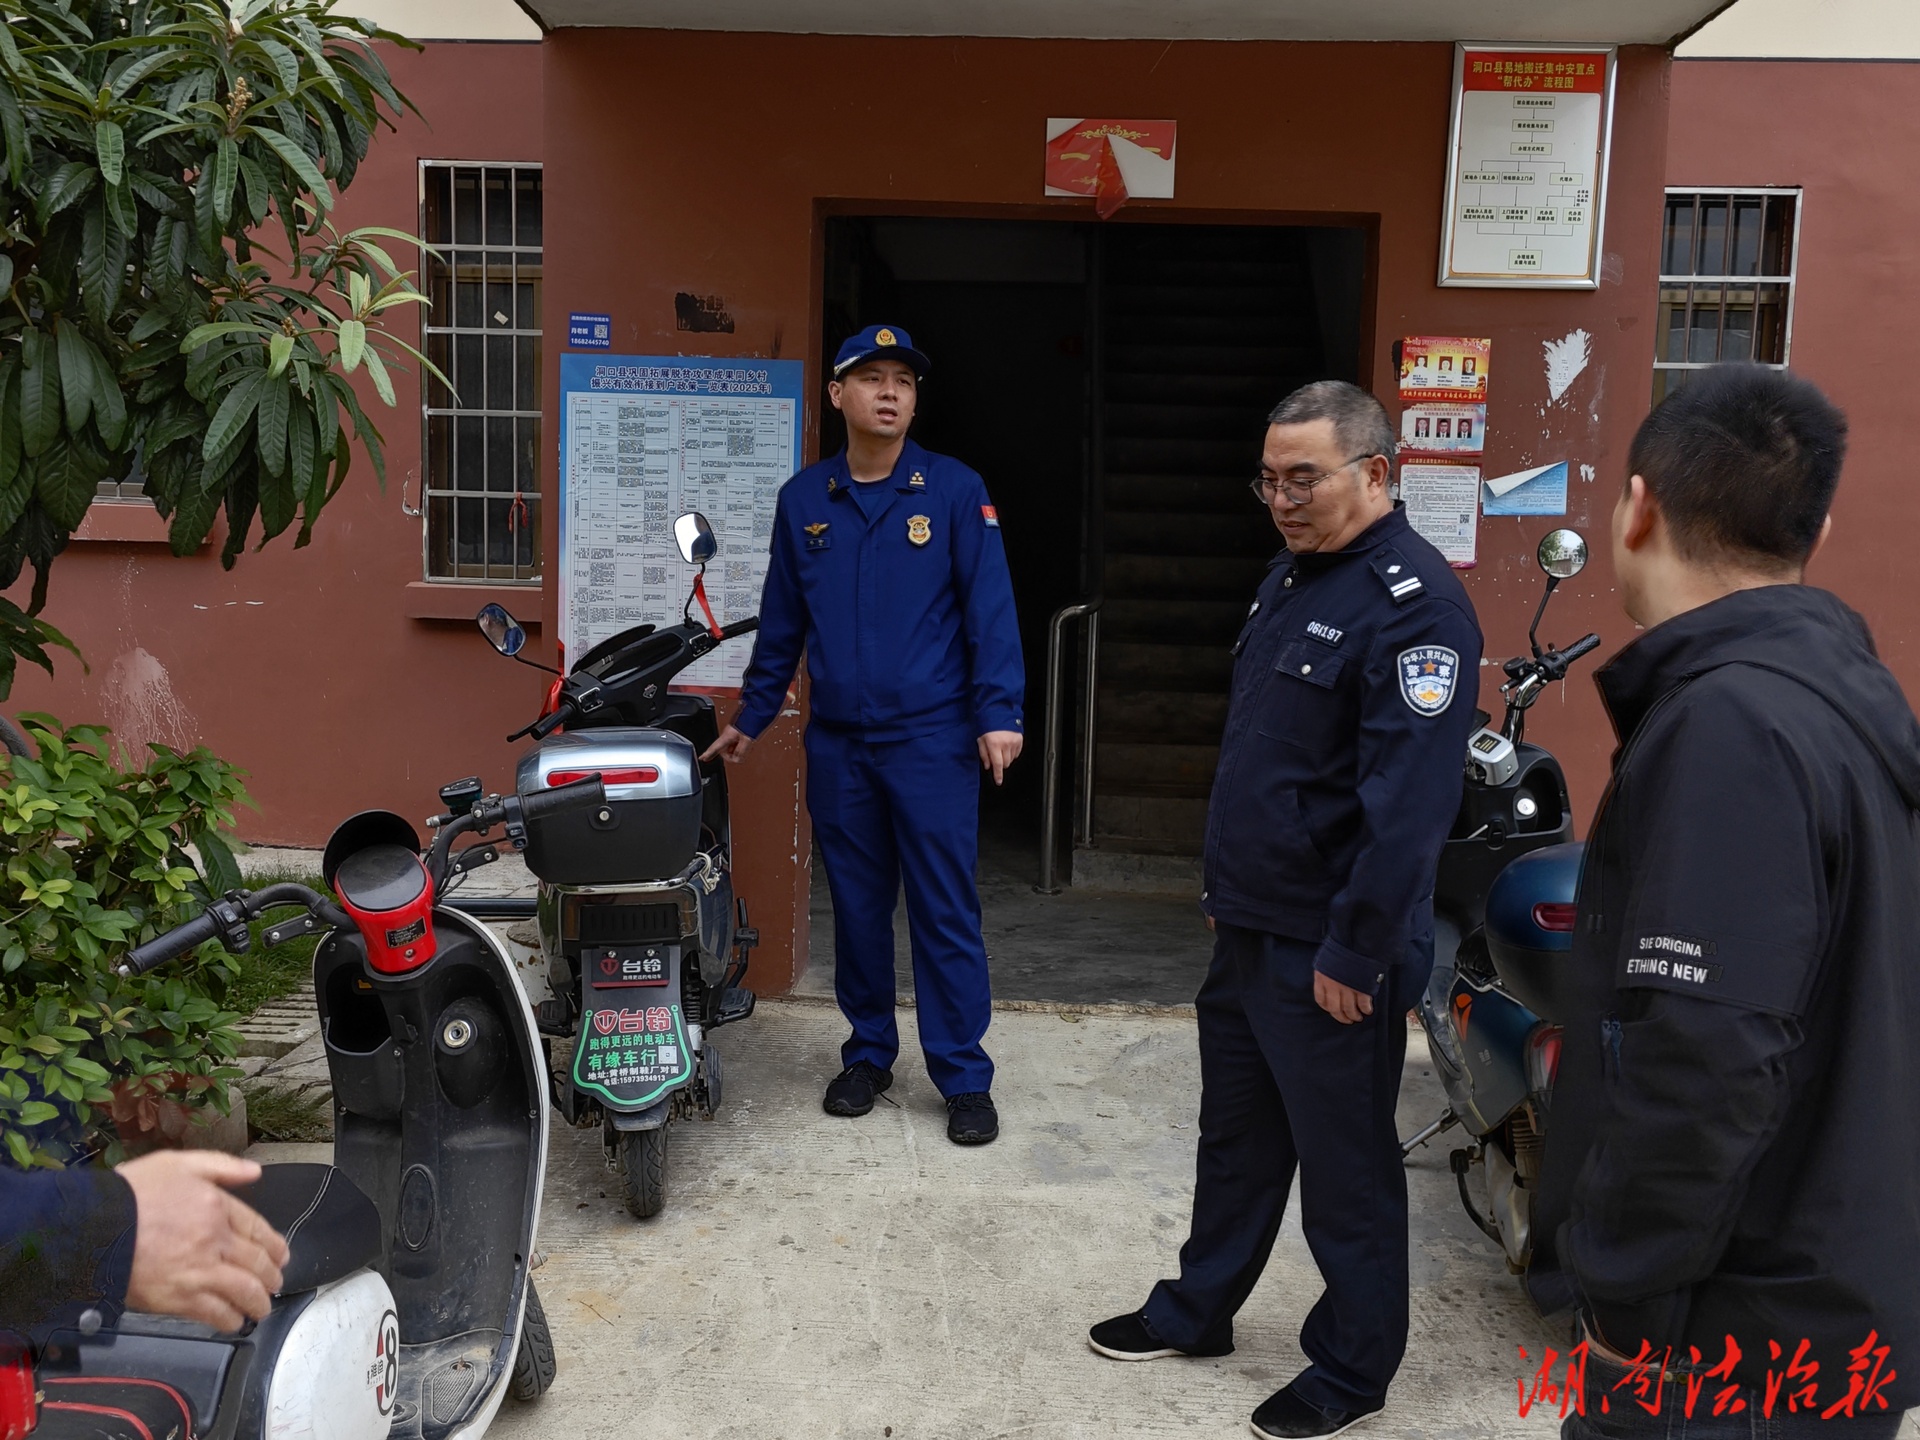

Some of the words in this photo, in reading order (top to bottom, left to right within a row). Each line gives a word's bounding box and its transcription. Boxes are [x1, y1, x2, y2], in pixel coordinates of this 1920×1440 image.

[1473, 61, 1596, 76] 洞口县易地搬迁集中安置点
[595, 365, 768, 382] 洞口县巩固拓展脱贫攻坚成果同乡村
[622, 958, 662, 974] 台铃
[1672, 963, 1708, 984] NEW
[618, 1006, 672, 1034] 台铃
[589, 1033, 676, 1051] 跑得更远的电动车
[588, 1048, 657, 1071] 有缘车行
